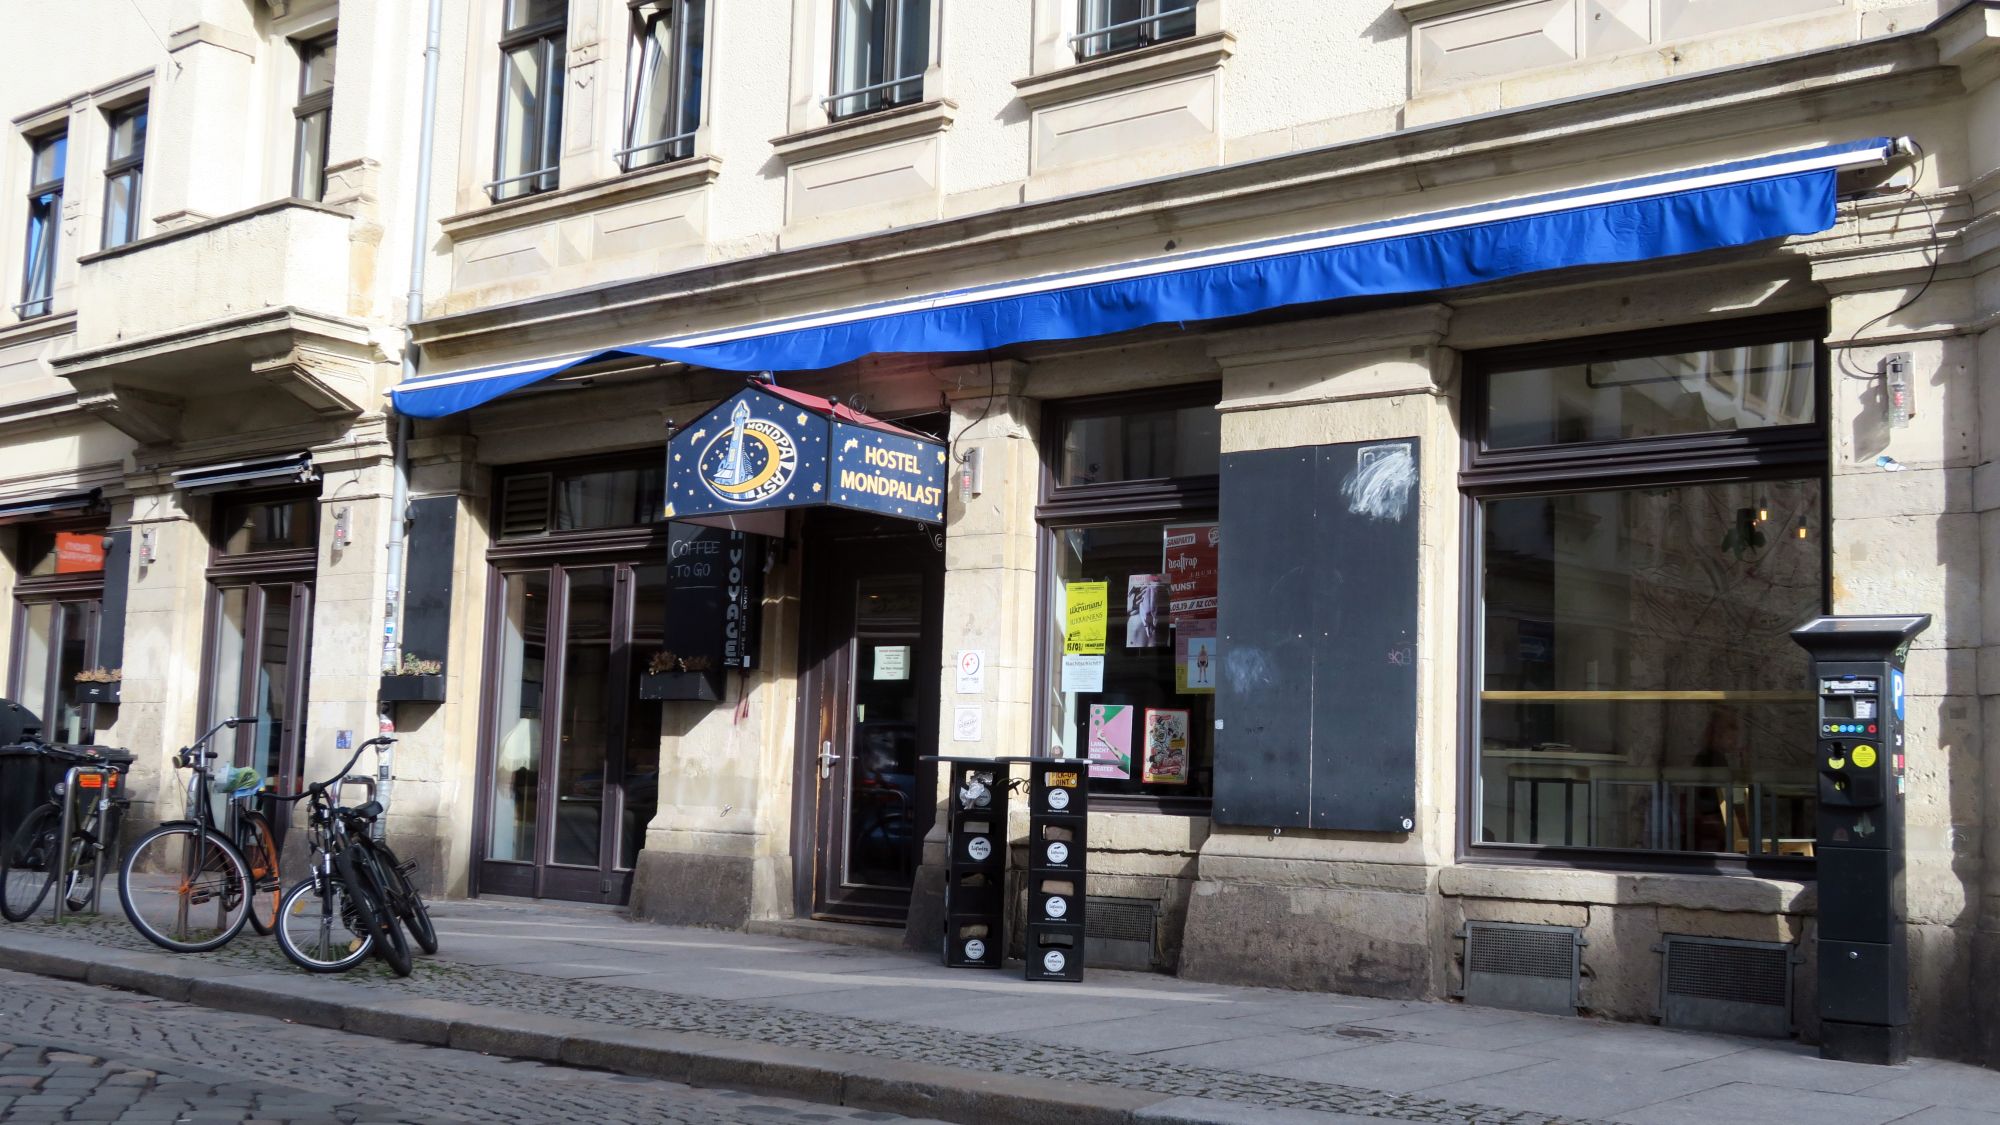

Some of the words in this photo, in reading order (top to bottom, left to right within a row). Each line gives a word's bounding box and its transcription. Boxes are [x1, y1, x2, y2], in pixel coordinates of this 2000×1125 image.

[747, 422, 795, 499] MONDPALAST
[865, 445, 922, 475] HOSTEL
[840, 469, 942, 507] MONDPALAST
[671, 539, 721, 559] COFFEE
[673, 564, 691, 578] TO
[693, 562, 711, 577] GO
[724, 548, 742, 657] VOYAGE
[1893, 674, 1903, 711] P
